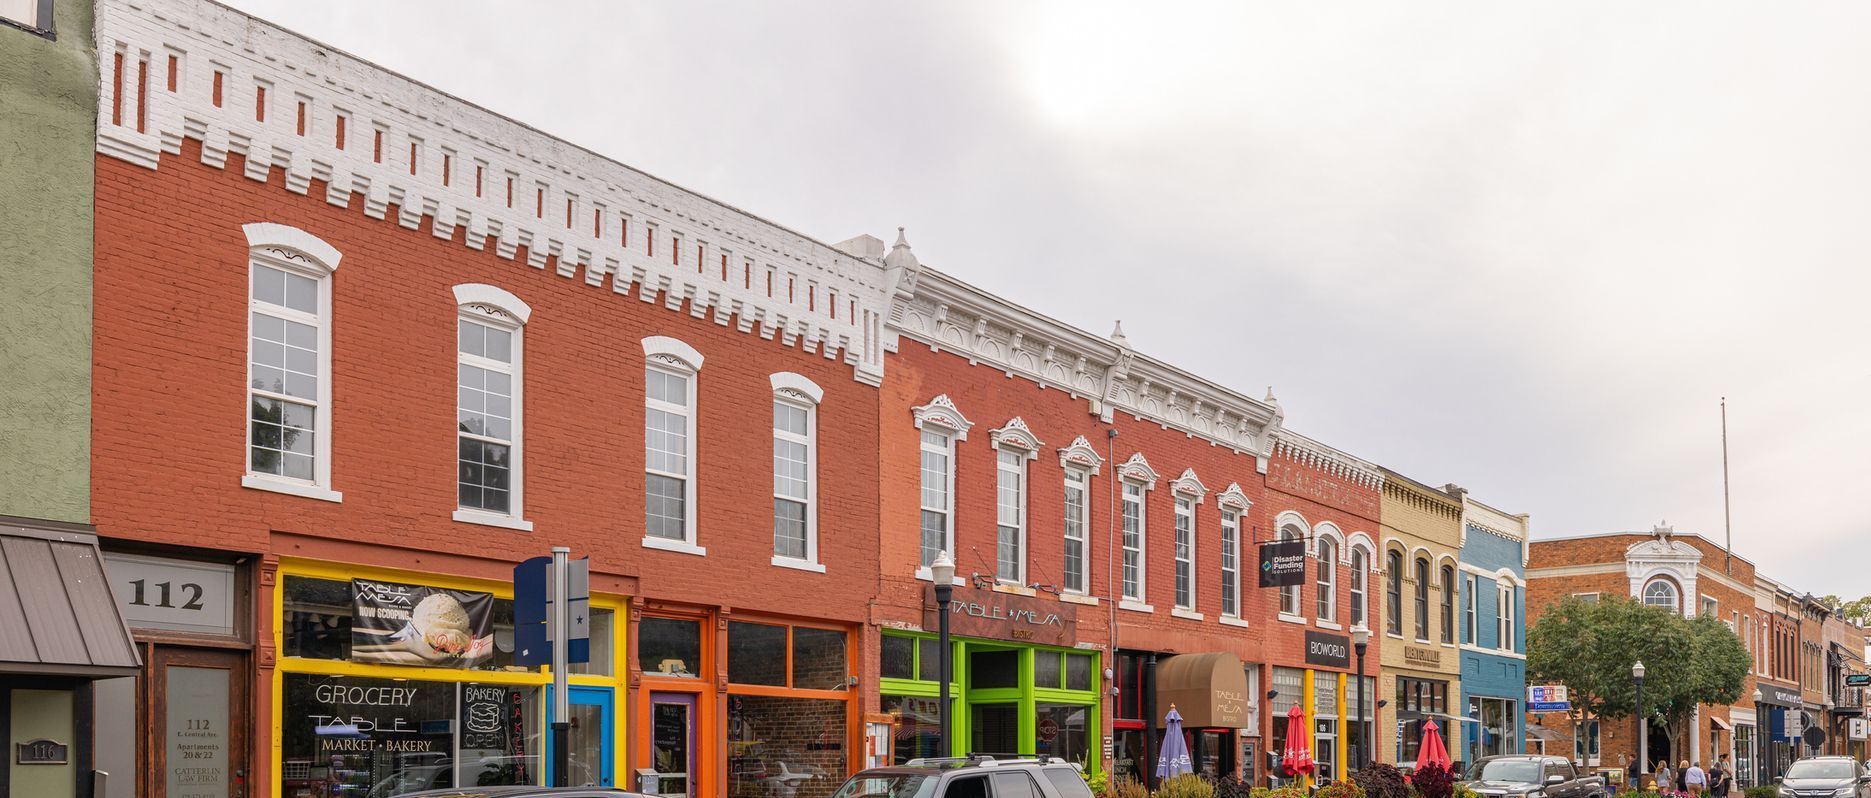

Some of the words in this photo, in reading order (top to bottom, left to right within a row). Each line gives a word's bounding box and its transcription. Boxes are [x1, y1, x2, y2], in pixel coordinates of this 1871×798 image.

[1273, 555, 1304, 564] Disaster
[1273, 561, 1304, 570] Funding
[128, 578, 204, 611] 112
[356, 581, 411, 596] TABLE
[355, 591, 411, 605] MESA
[359, 606, 376, 618] NOW
[951, 599, 1007, 620] TABLE
[1015, 609, 1062, 626] MESA
[1310, 641, 1345, 658] BIOWORLD
[315, 684, 417, 706] GROCERY
[466, 687, 505, 703] BAKERY
[1215, 690, 1244, 701] TABLE
[1216, 704, 1243, 713] MESA
[187, 719, 210, 730] 112
[308, 715, 417, 732] TABLE
[177, 743, 220, 751] Apartments
[322, 739, 377, 751] MARKET
[386, 740, 432, 752] BAKERY
[465, 733, 504, 748] OPEN
[32, 744, 54, 760] 116
[183, 751, 193, 759] 20
[194, 751, 202, 759] &
[203, 751, 213, 759] 22
[174, 767, 221, 775] CATTERLIN
